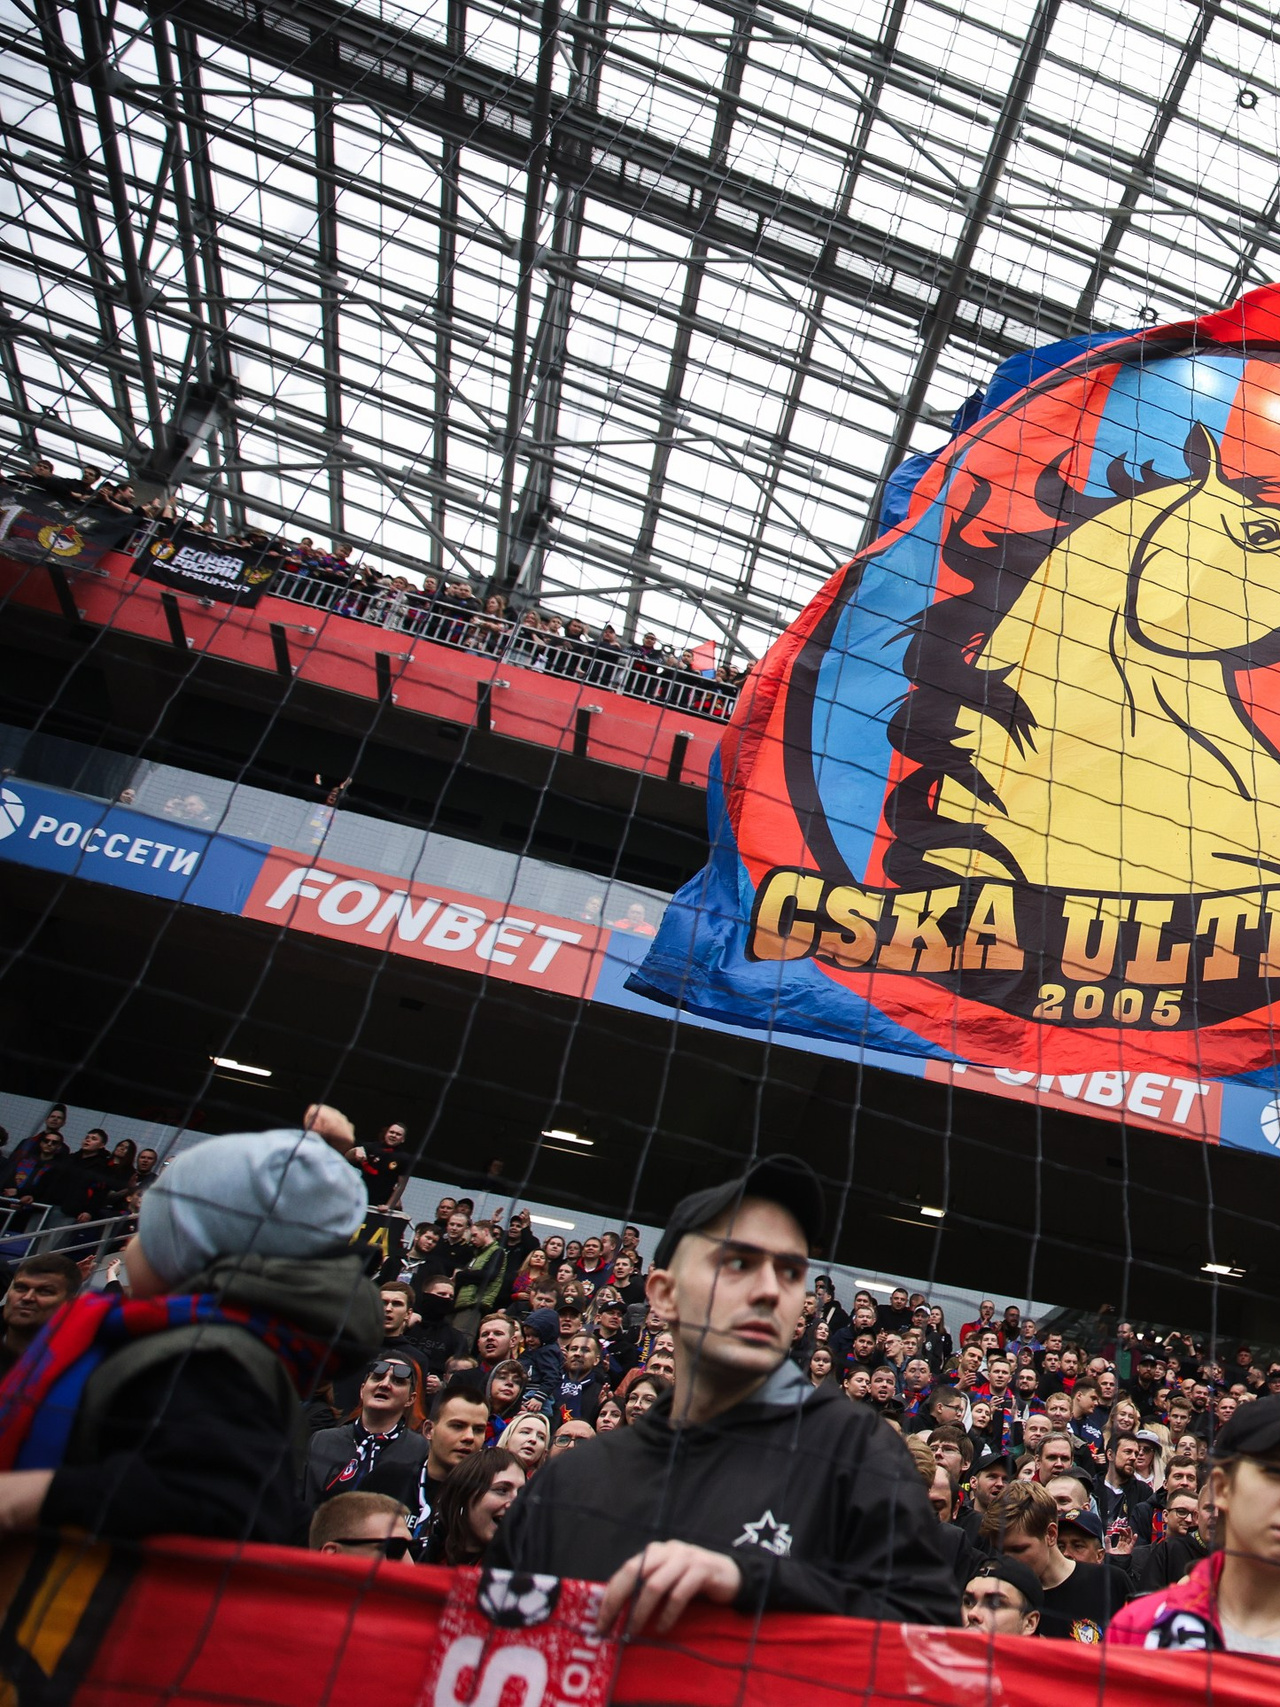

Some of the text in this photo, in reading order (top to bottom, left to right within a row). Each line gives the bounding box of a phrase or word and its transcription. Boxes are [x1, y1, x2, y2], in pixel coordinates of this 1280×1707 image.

[171, 556, 240, 580] РОССИИ
[178, 546, 244, 571] СЛАВА
[29, 813, 200, 876] РОССЕТИ
[265, 867, 582, 974] FONBET
[753, 871, 1025, 973] CSKA
[1032, 983, 1183, 1027] 2005
[951, 1064, 1210, 1125] NBET
